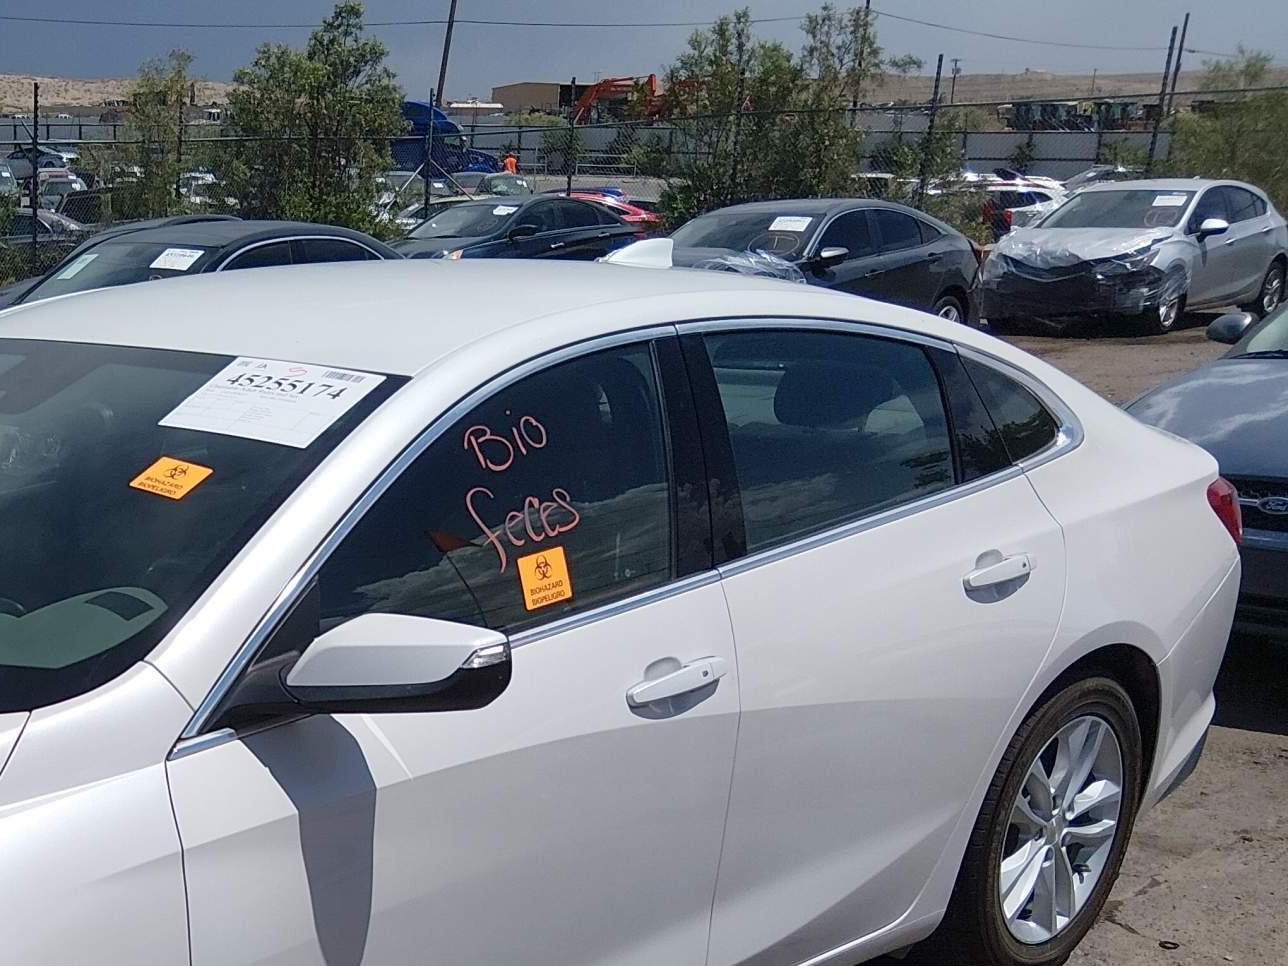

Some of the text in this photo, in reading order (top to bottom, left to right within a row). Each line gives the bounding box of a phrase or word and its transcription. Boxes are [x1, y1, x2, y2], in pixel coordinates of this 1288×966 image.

[226, 373, 348, 400] 45255174
[143, 476, 184, 490] BIOHAZARD
[530, 580, 564, 596] BIOHAZARD
